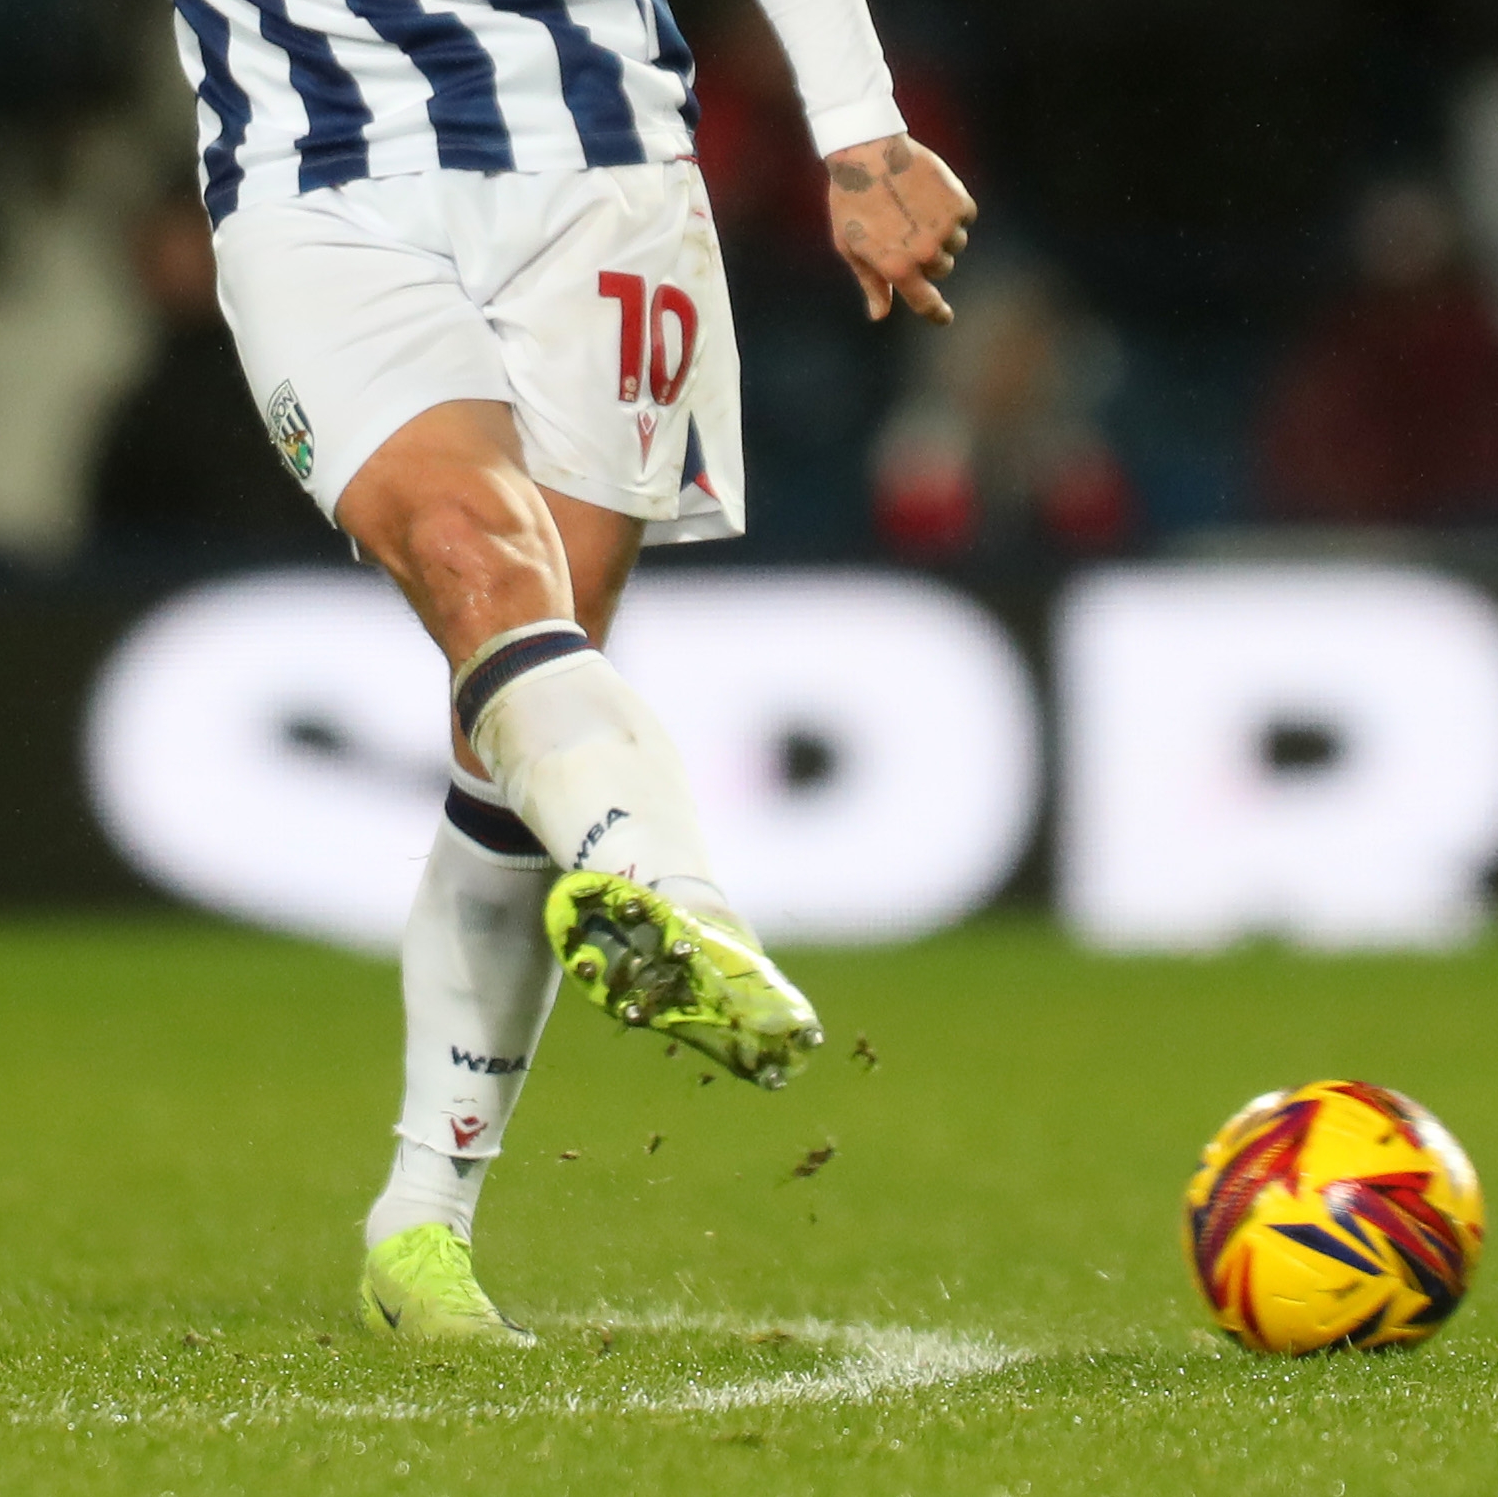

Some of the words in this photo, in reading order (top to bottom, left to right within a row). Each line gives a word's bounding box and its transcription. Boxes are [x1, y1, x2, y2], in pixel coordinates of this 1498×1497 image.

[598, 270, 699, 406] 10
[572, 806, 631, 870] WBA
[450, 1044, 528, 1075] WBA
